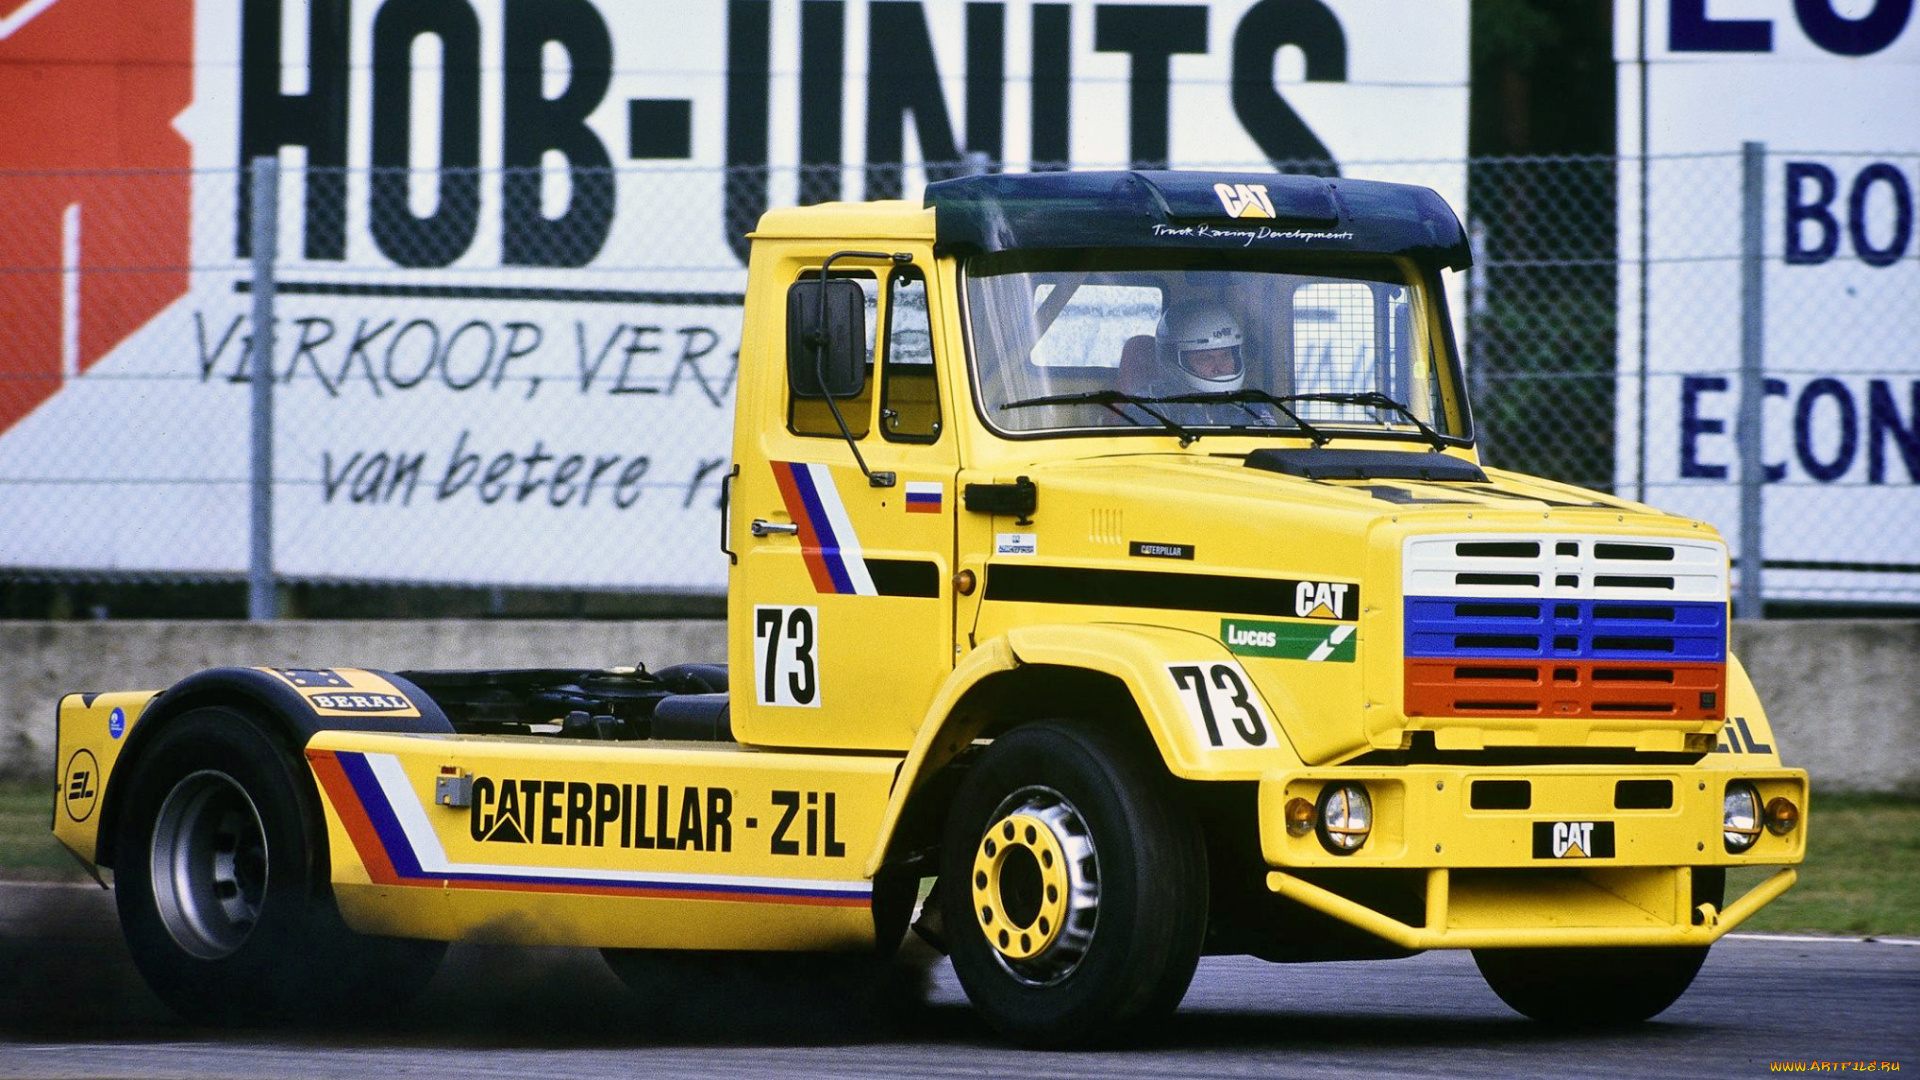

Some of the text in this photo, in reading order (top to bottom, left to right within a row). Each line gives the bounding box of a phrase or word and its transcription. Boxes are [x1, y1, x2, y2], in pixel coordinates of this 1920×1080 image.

[237, 0, 1348, 269] HOB-UNITS
[1213, 183, 1277, 219] CAT
[1152, 223, 1354, 247] Truck Racing Developments
[322, 451, 426, 507] van
[437, 430, 651, 509] betere
[1140, 544, 1182, 557] CATERPILLAR
[1295, 581, 1348, 619] CAT
[1228, 624, 1277, 648] Lucas
[756, 608, 816, 705] 73
[312, 695, 409, 709] BERAL
[1168, 664, 1268, 748] 73
[470, 776, 733, 852] CATERPILLAR
[770, 789, 846, 858] ZiL
[1552, 821, 1594, 859] CAT
